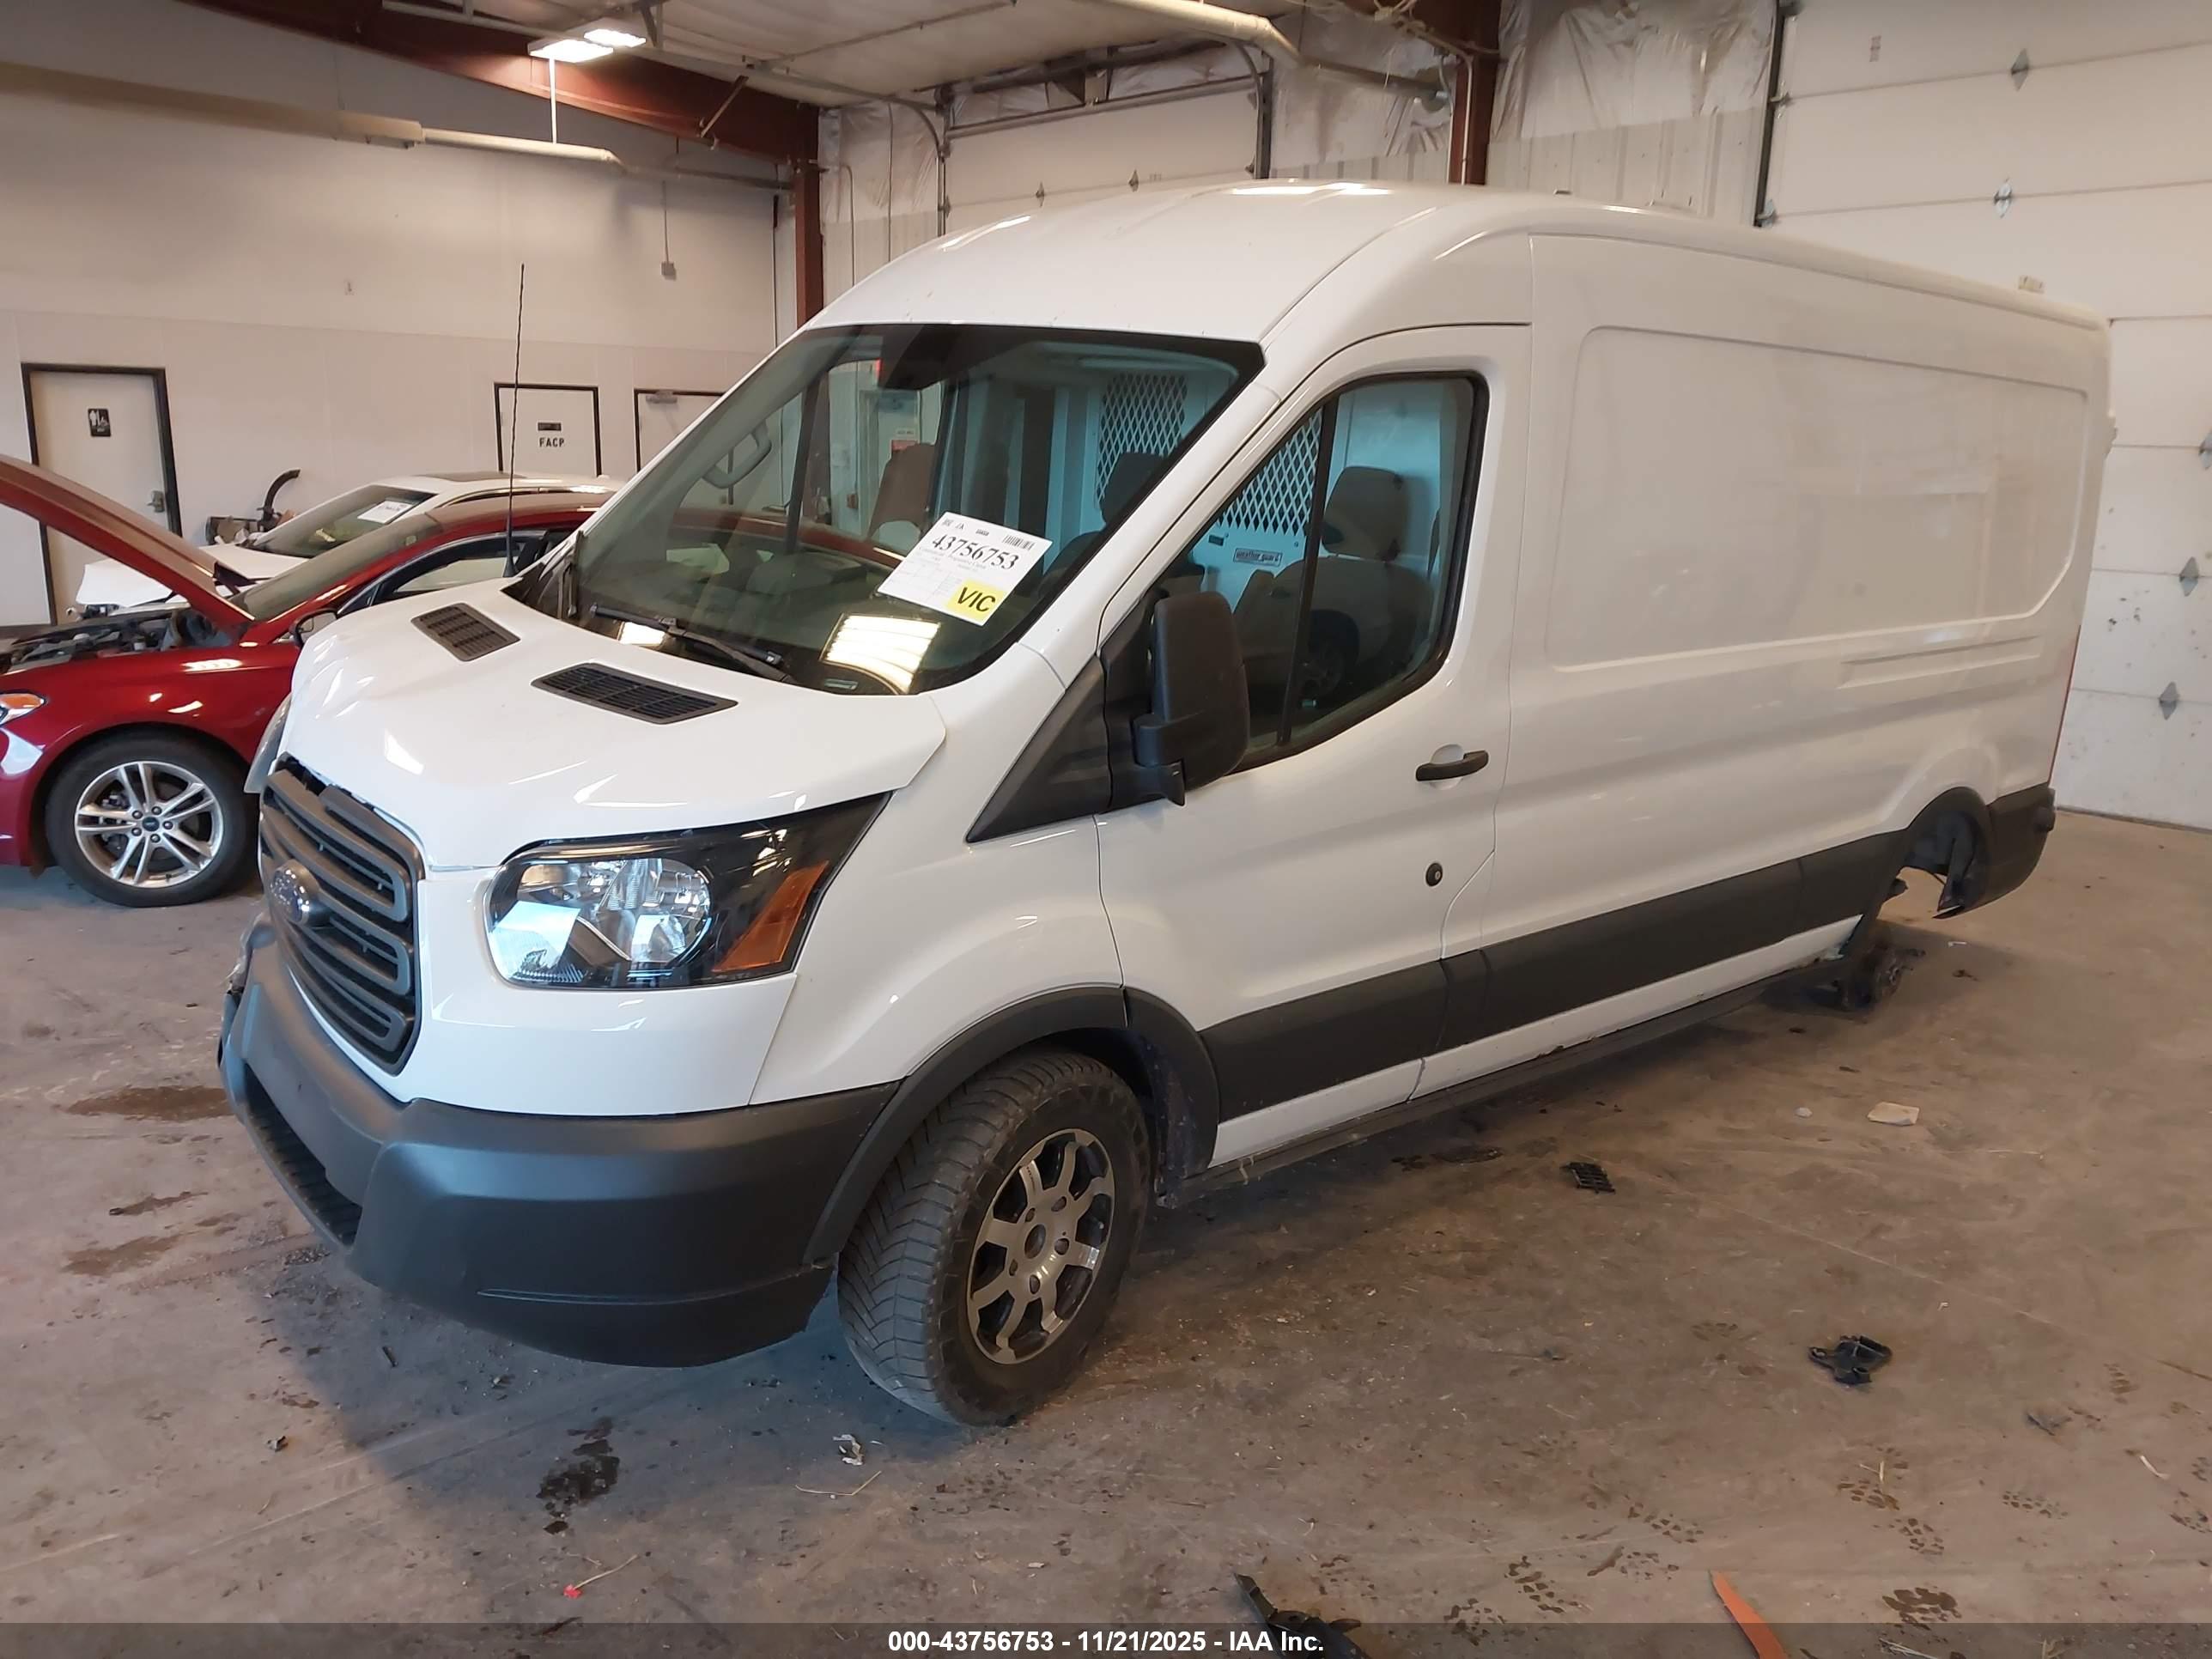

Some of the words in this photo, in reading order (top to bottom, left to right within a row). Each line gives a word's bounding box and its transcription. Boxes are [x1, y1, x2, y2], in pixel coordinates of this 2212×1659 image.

[539, 437, 565, 447] FACP
[932, 534, 1020, 569] 43756753
[957, 586, 997, 612] VIC
